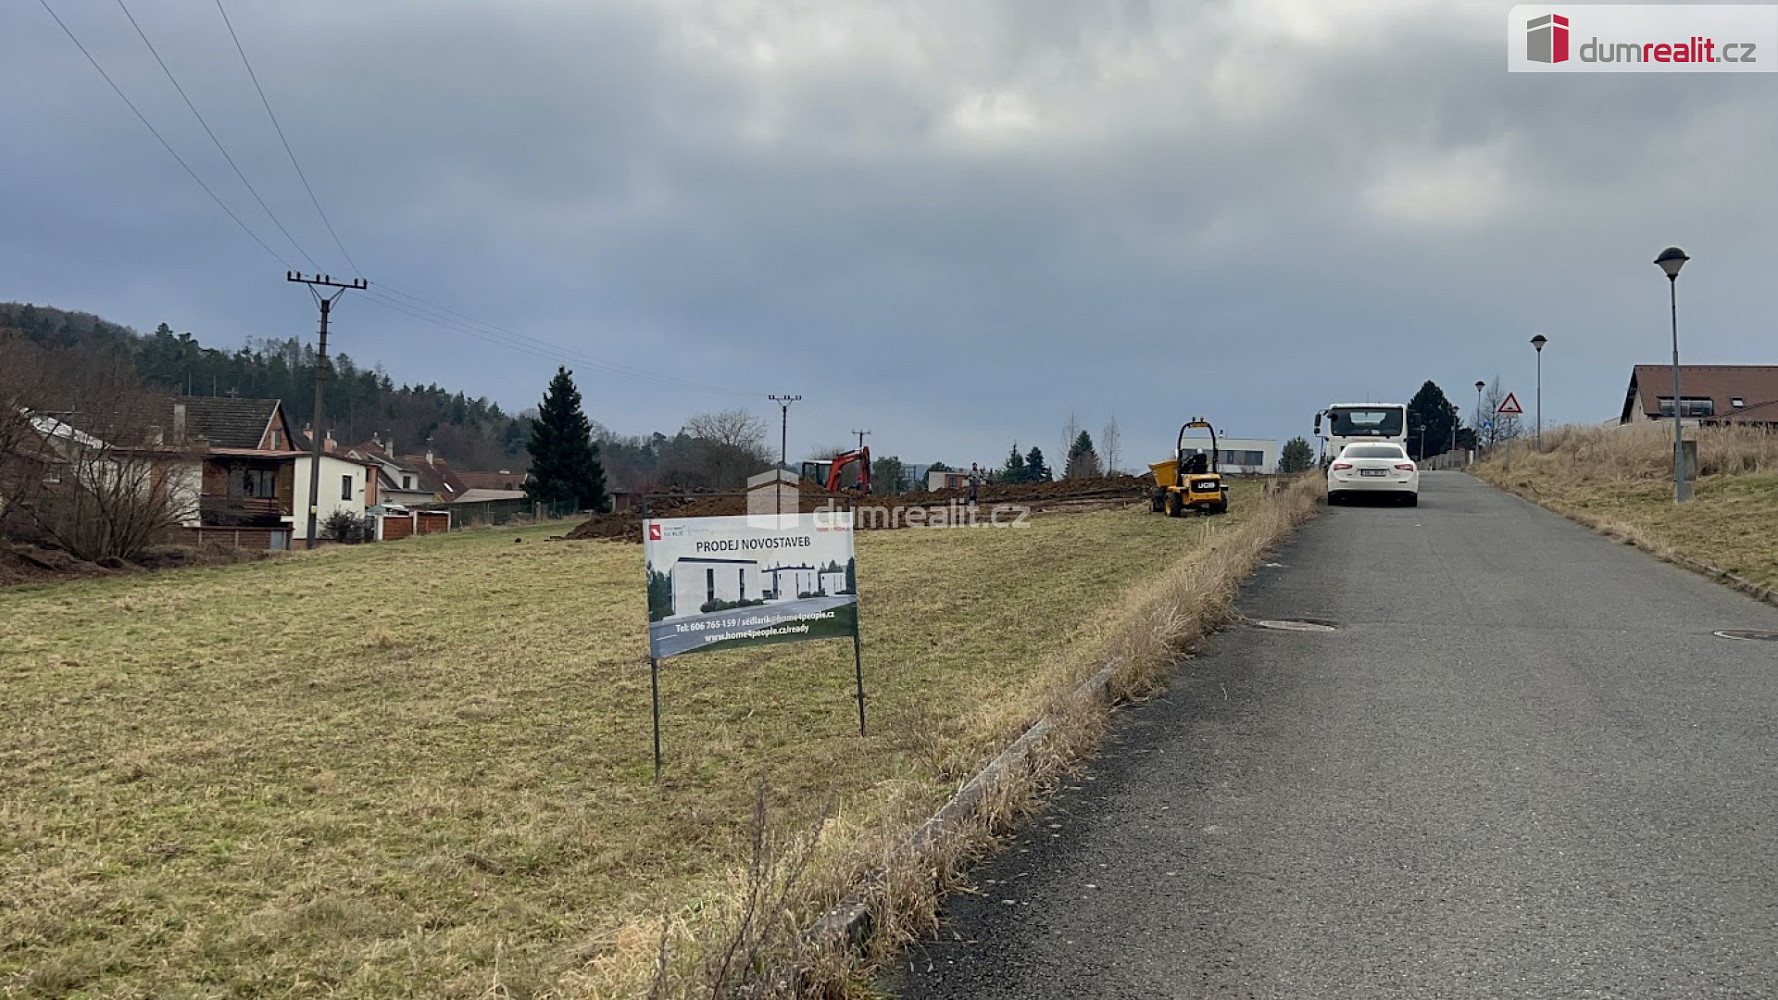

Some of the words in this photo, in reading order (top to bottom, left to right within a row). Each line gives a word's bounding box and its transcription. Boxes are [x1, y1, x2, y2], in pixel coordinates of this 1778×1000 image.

[696, 538, 739, 553] PRODEJ
[741, 536, 811, 551] NOVOSTAVEB
[675, 624, 689, 633] Tel:
[690, 621, 706, 631] 606
[706, 620, 720, 630] 765
[722, 618, 736, 628] 159
